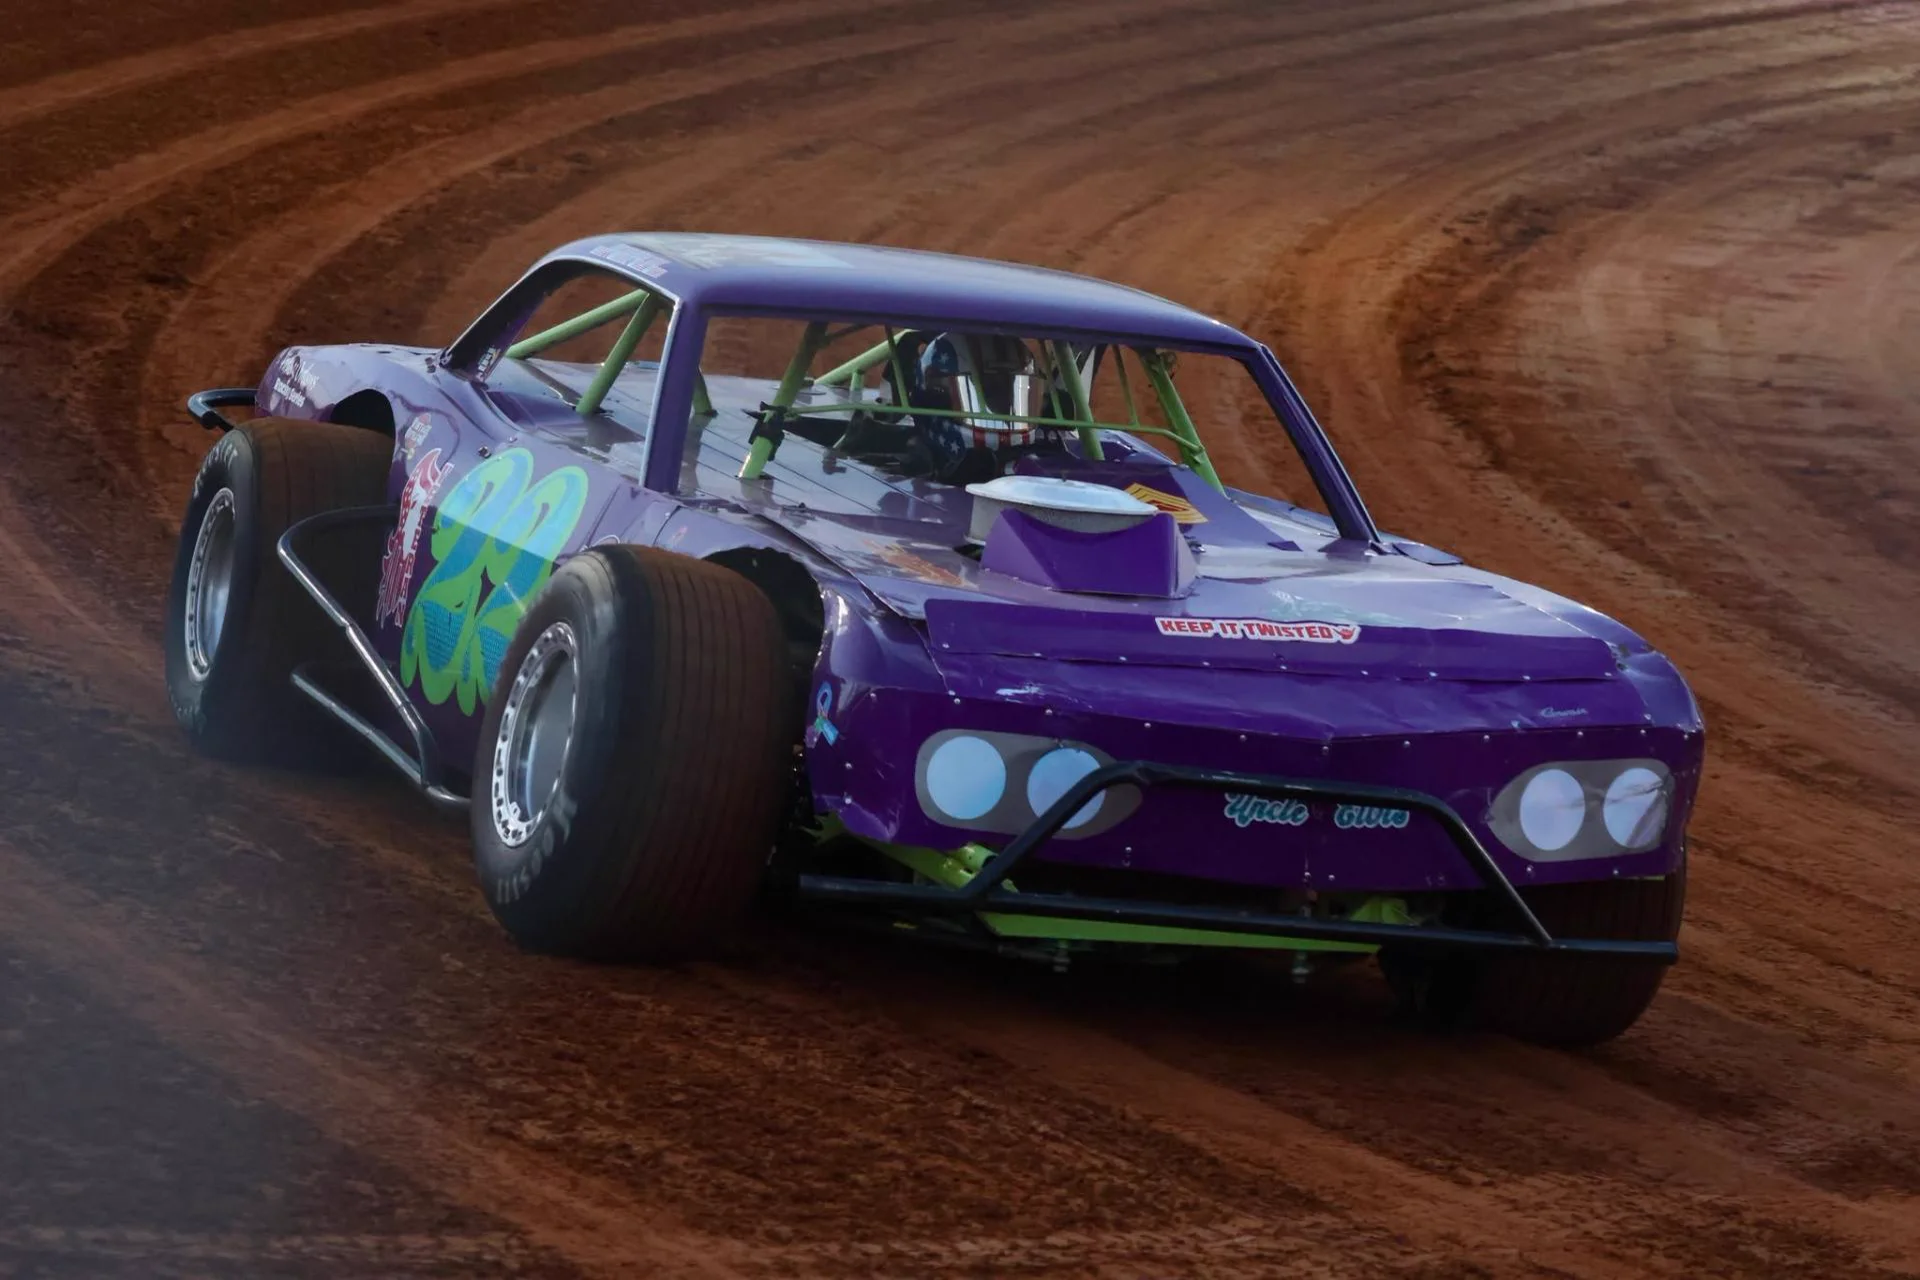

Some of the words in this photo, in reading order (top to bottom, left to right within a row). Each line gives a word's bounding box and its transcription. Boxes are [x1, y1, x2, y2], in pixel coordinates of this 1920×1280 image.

[1159, 619, 1214, 634] KEEP
[1219, 621, 1239, 636] IT
[1242, 622, 1334, 639] TWISTED
[1223, 792, 1310, 828] Uncle
